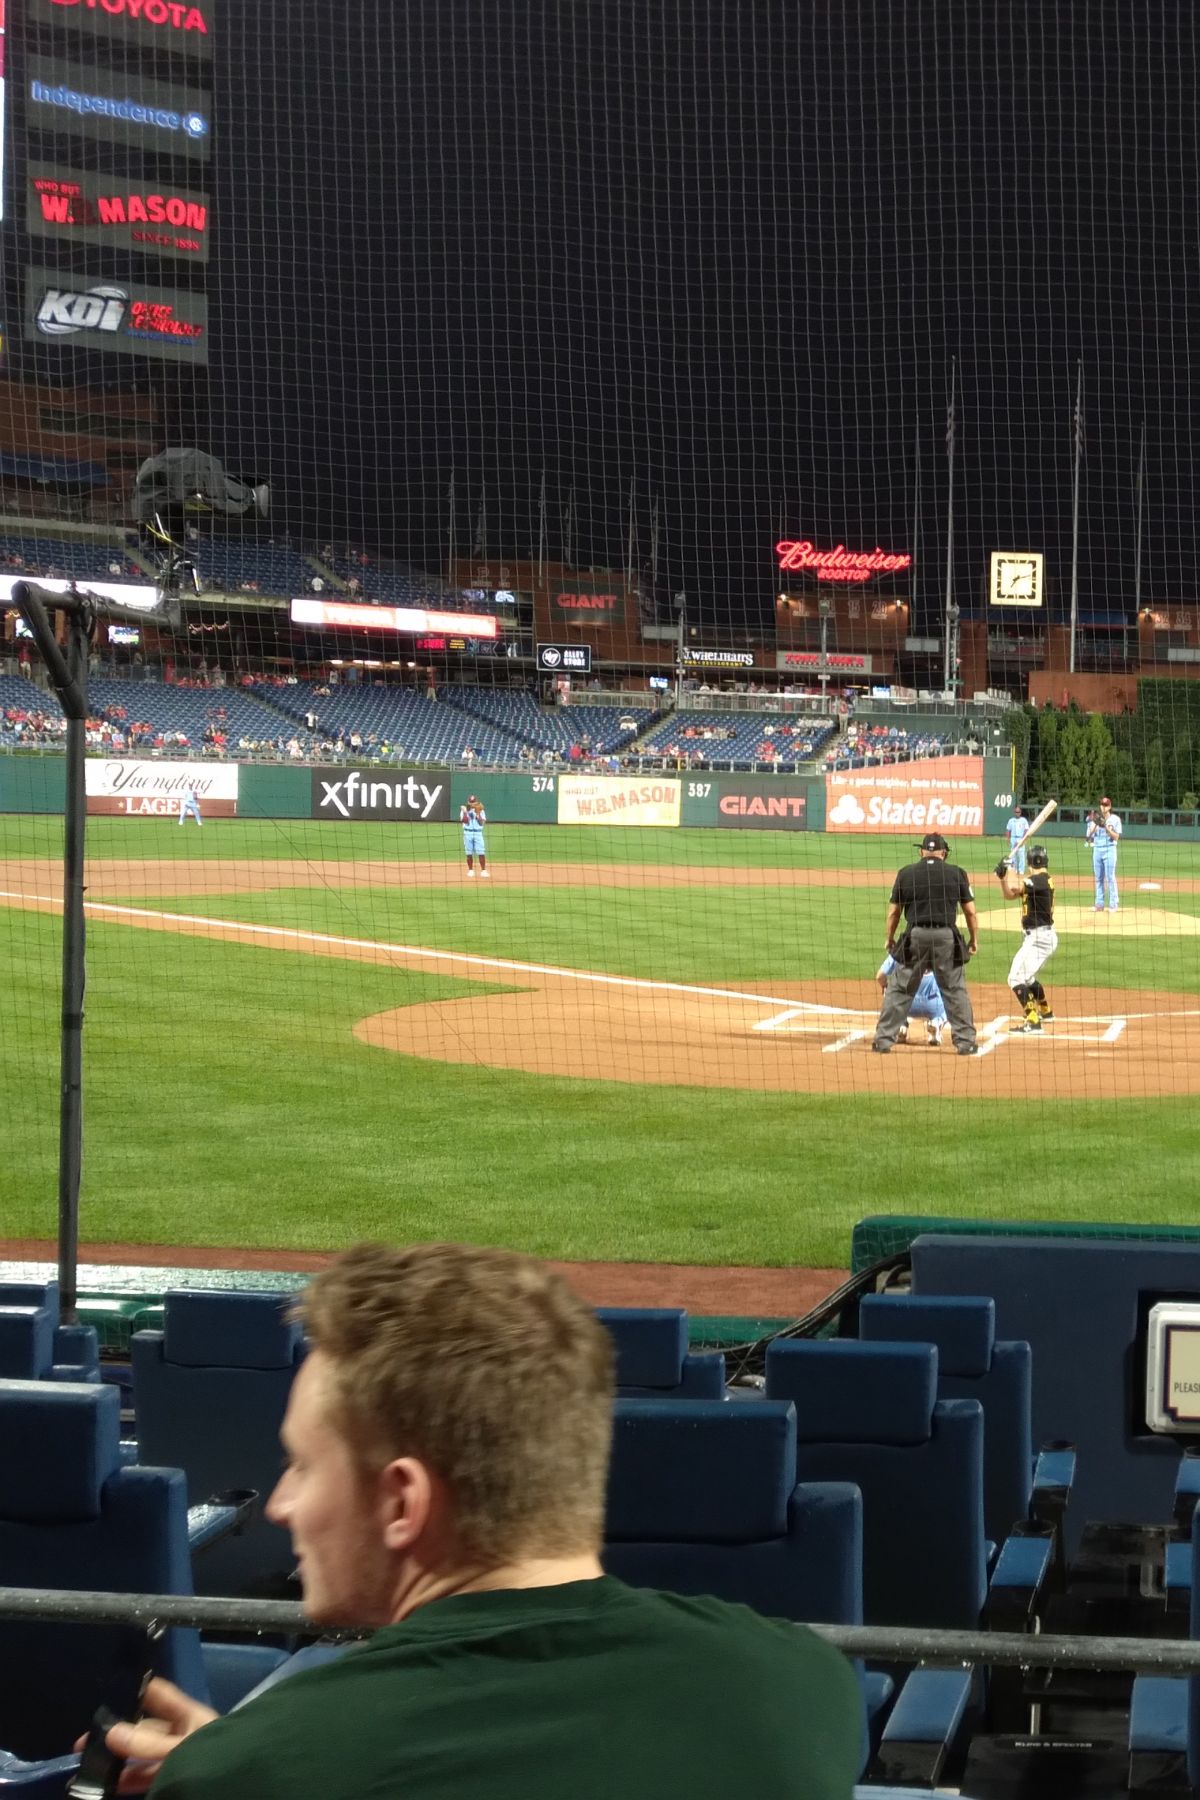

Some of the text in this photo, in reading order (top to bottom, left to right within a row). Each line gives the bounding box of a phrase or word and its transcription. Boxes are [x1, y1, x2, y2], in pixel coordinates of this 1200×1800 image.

[31, 79, 180, 131] Independence
[97, 195, 207, 232] MASON
[776, 541, 911, 570] Budweiser
[817, 569, 870, 580] ROOFTOP
[557, 593, 617, 609] GIANT
[102, 762, 214, 795] Yuengling
[532, 777, 554, 792] 374
[320, 772, 443, 818] xfinity
[688, 782, 711, 798] 387
[719, 796, 806, 817] GIANT
[994, 794, 1012, 808] 409
